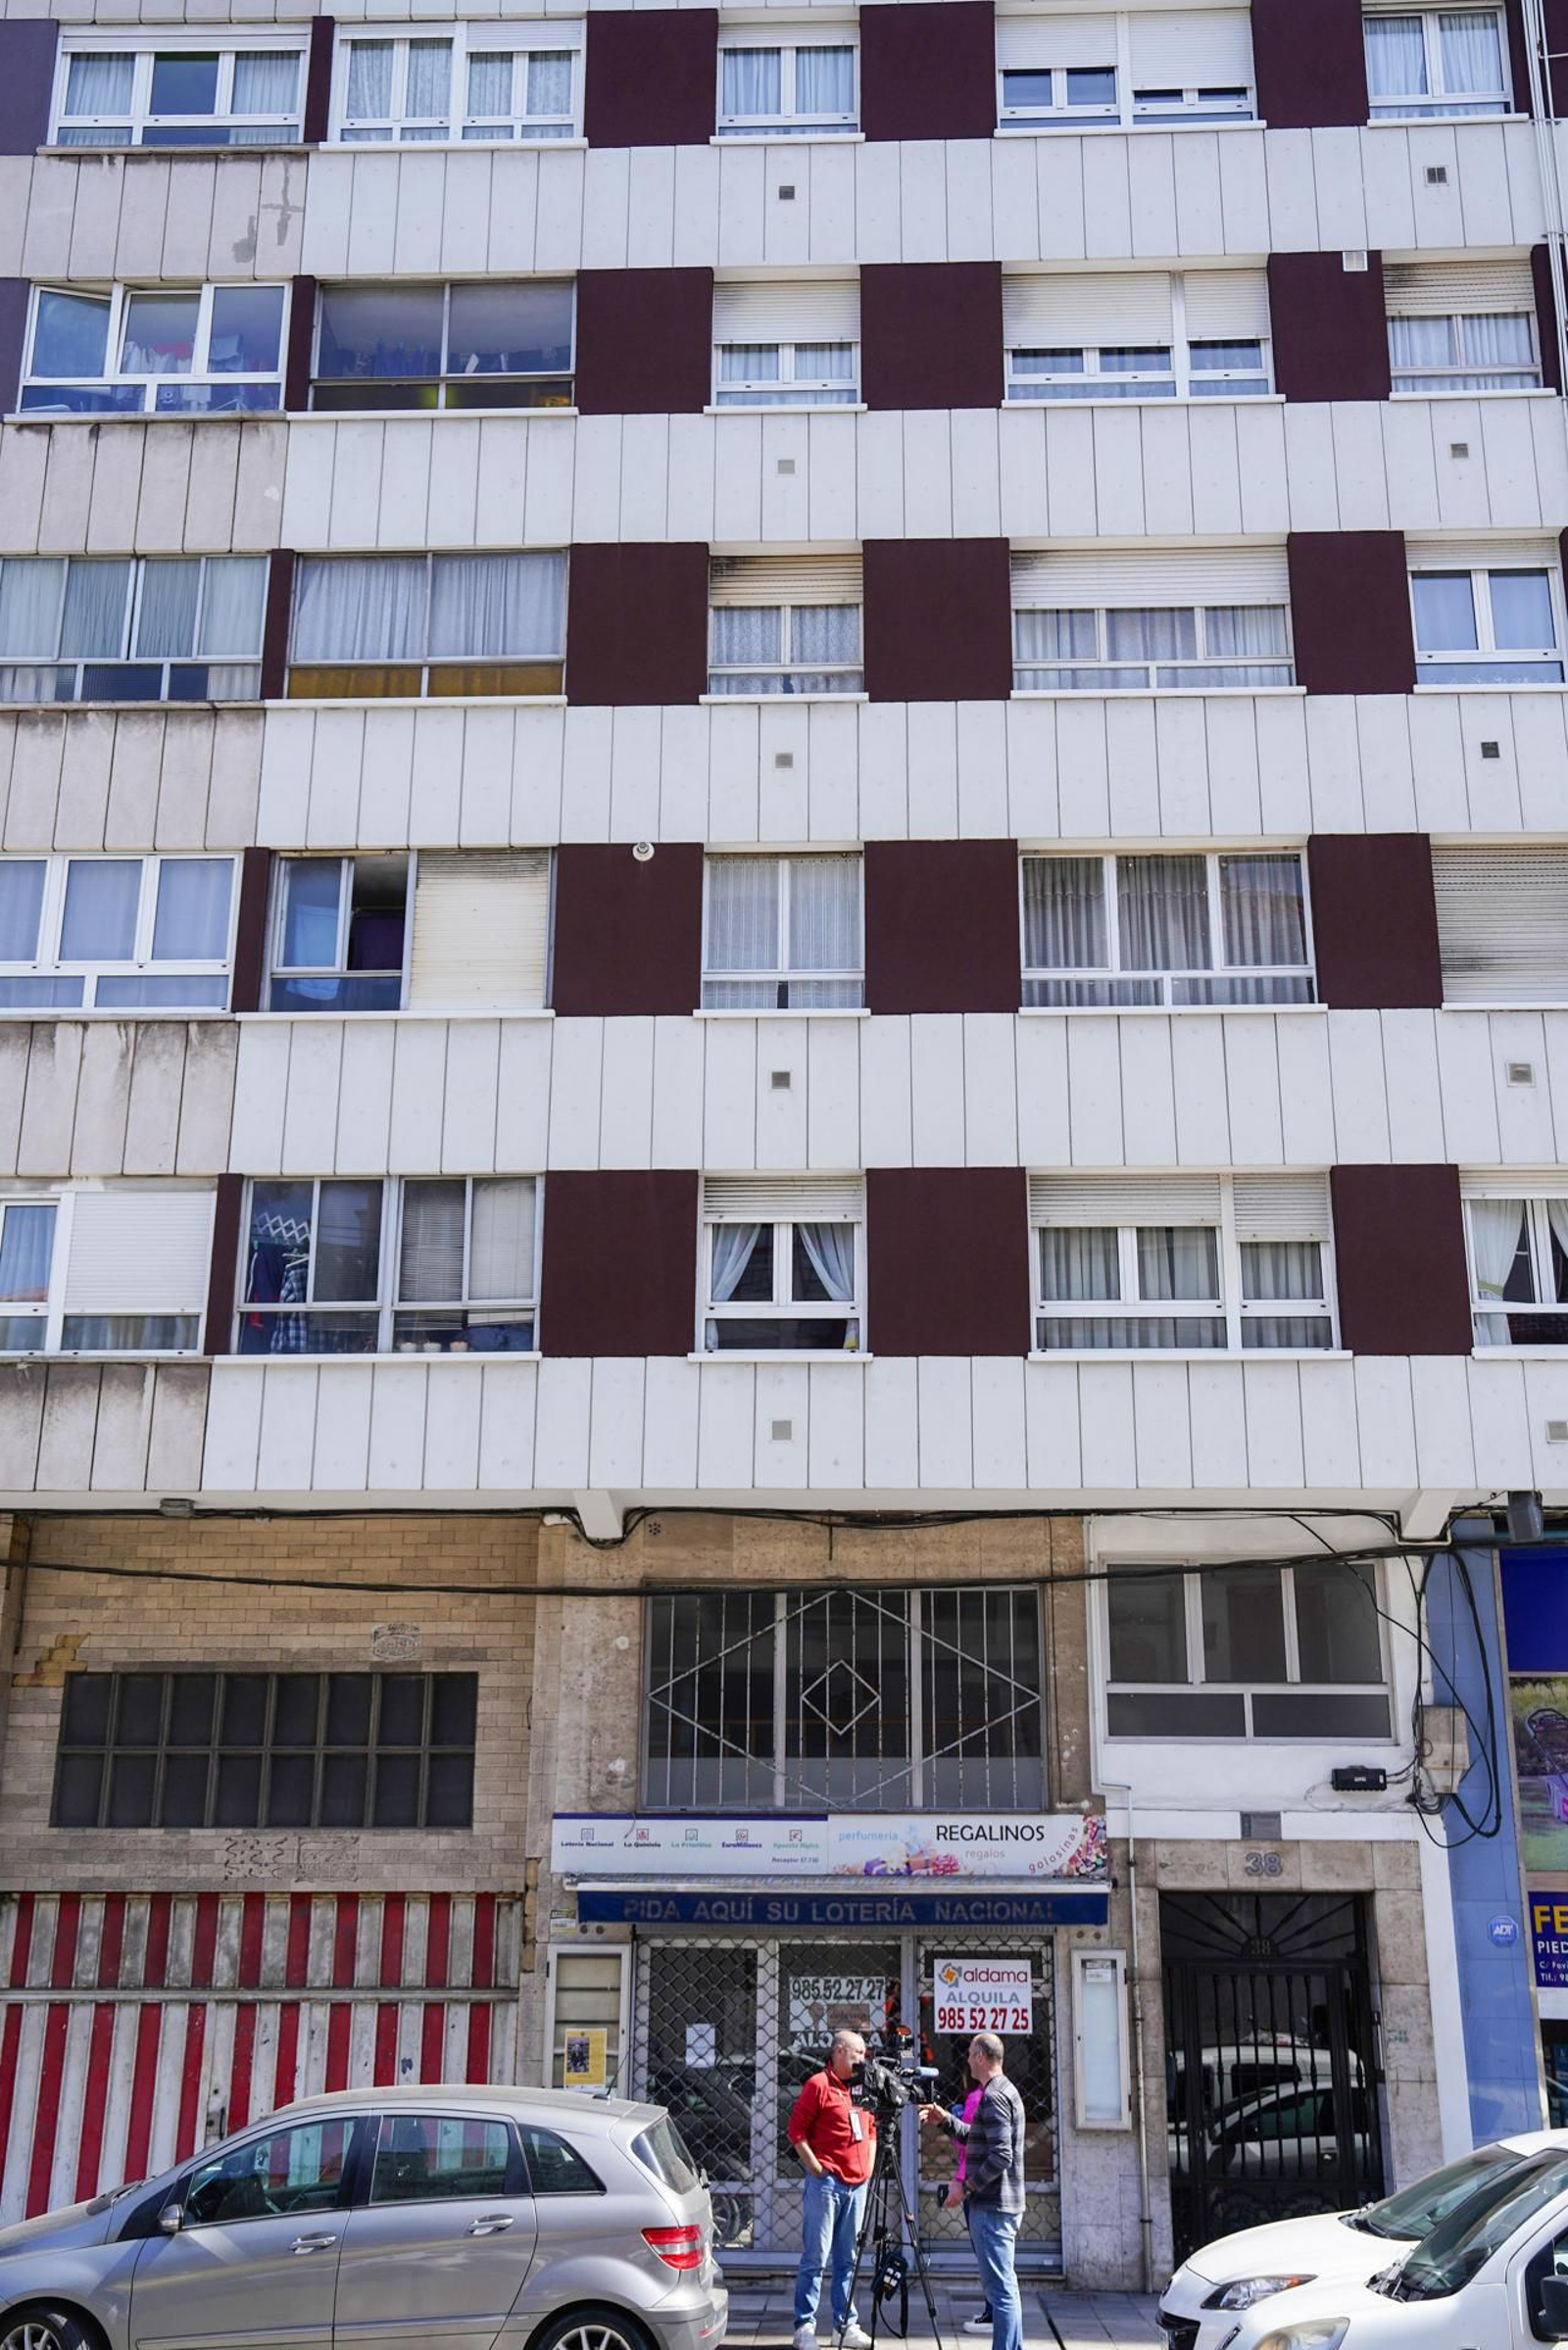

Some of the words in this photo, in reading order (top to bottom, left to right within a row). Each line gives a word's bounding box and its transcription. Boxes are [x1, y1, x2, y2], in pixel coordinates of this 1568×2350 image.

[936, 1825, 1045, 1841] REGALINOS
[965, 1848, 1005, 1862] regalos
[1028, 1826, 1079, 1874] golosinas
[1245, 1852, 1283, 1877] 38
[624, 1899, 680, 1920] PIDA
[693, 1896, 753, 1921] AQUÍ
[766, 1899, 799, 1921] SU
[811, 1897, 916, 1922] LOTERÍA
[934, 1900, 1055, 1921] NACIONAL
[1493, 1924, 1513, 1937] ADT
[963, 1967, 1028, 1983] aldama
[792, 1979, 820, 2000] 985
[822, 1979, 842, 2000] 52
[846, 1979, 863, 2000] 27
[866, 1979, 885, 2000] 27
[946, 1991, 1020, 2005] ALQUILA
[938, 2007, 964, 2031] 985
[969, 2007, 986, 2031] 52
[990, 2007, 1008, 2031] 27
[1011, 2007, 1029, 2031] 25
